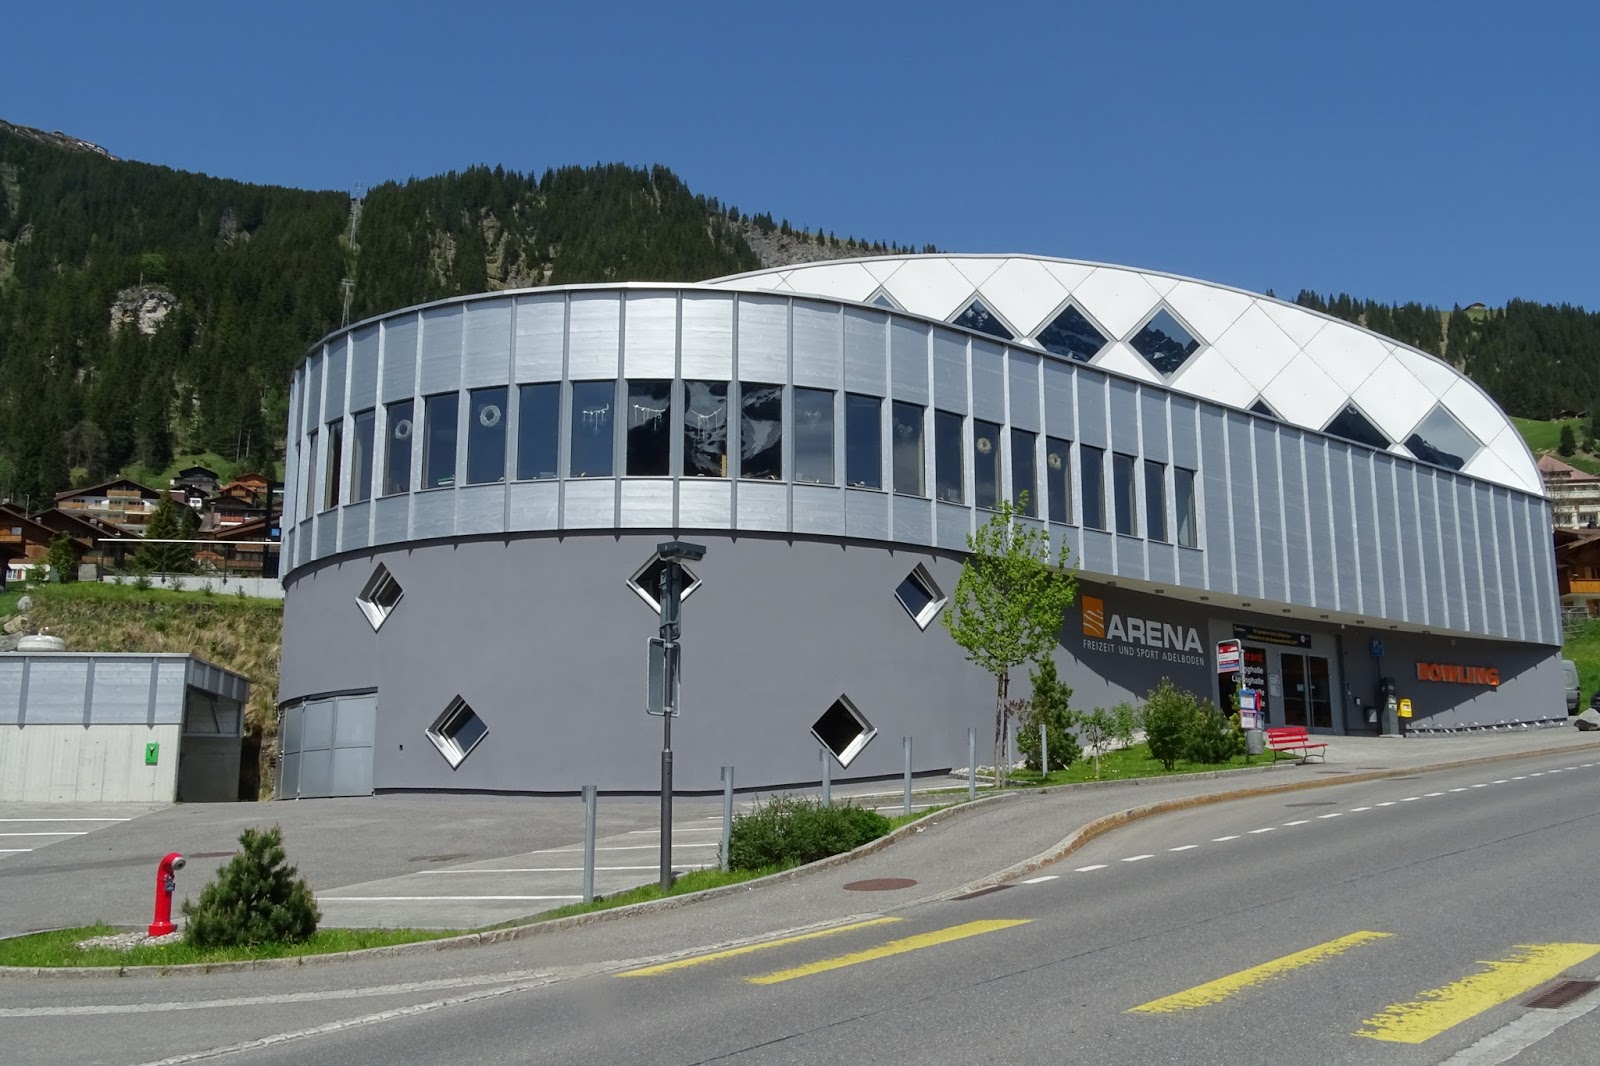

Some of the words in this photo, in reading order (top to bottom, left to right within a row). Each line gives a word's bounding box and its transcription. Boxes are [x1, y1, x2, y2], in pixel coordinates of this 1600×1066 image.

[1107, 614, 1204, 654] ARENA
[1083, 639, 1115, 653] FREIZEIT
[1118, 645, 1135, 656] UND
[1136, 648, 1159, 659] SPORT
[1162, 652, 1205, 666] ADELBODEN
[1417, 662, 1500, 686] BOWLING
